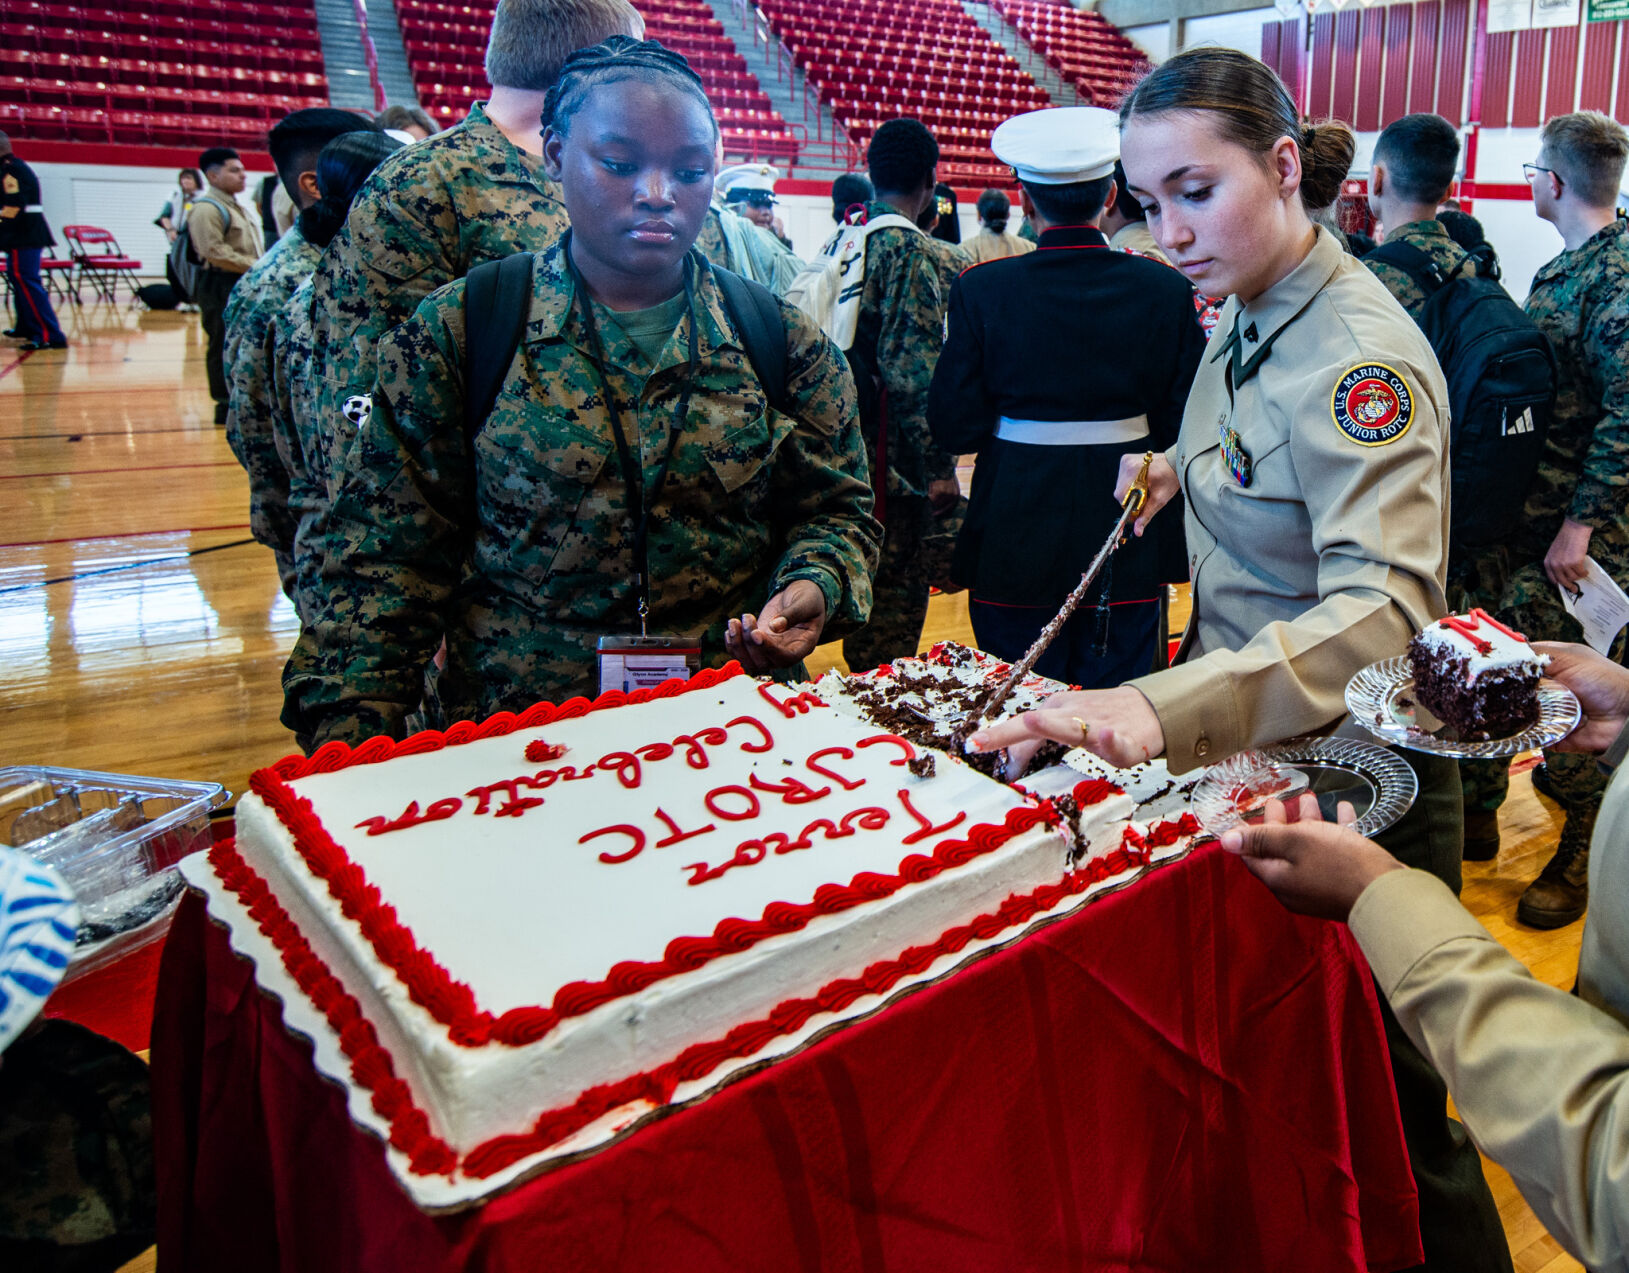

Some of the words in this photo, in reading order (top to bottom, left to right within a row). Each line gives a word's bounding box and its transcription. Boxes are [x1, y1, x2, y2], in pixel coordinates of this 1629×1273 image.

[1335, 390, 1347, 410] U.S.
[1343, 367, 1389, 388] MARINE
[1390, 377, 1410, 412] CORPS
[1337, 414, 1378, 440] JUNIOR
[1380, 414, 1408, 438] ROTC
[353, 715, 775, 836] Celebration
[681, 788, 967, 886] Terror
